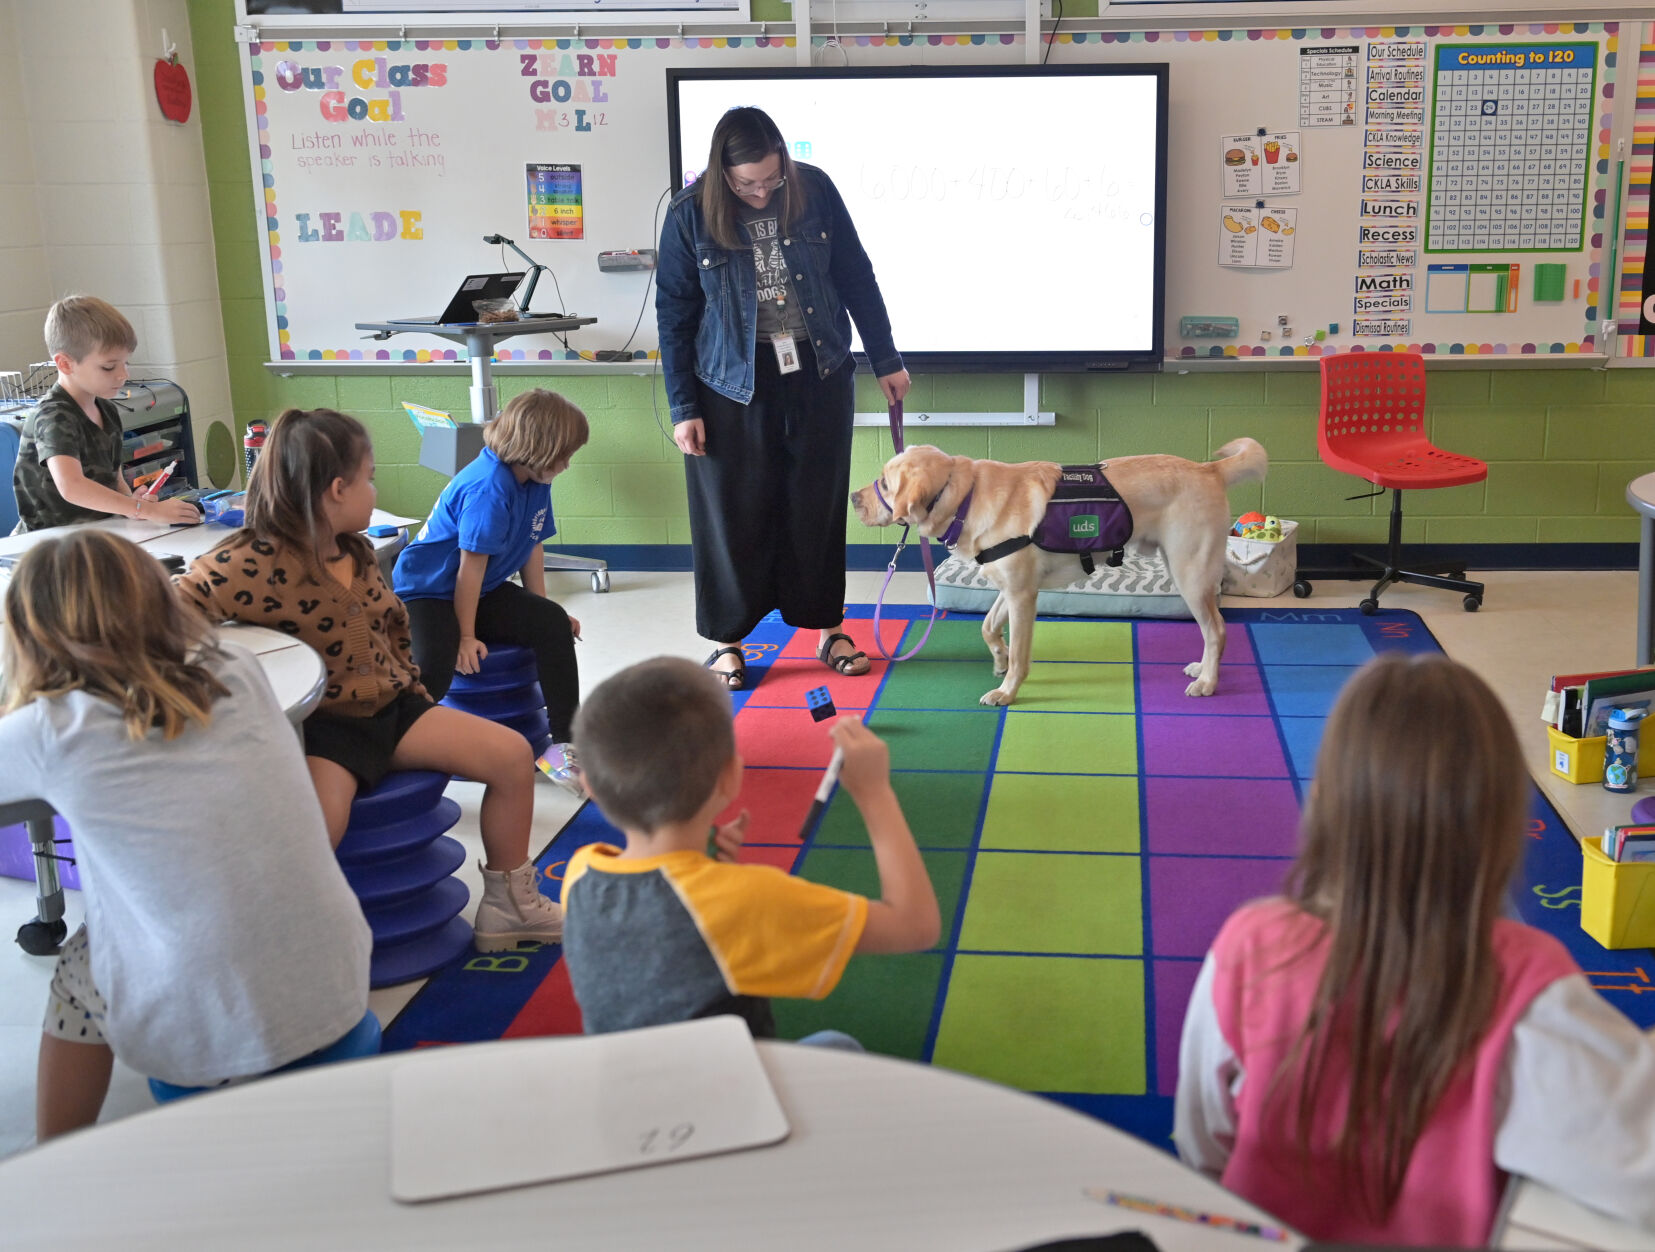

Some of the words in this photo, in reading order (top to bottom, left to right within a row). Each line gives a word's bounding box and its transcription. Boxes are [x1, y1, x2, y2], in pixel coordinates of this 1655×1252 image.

[1370, 46, 1386, 57] Our
[1387, 44, 1423, 57] Schedule
[1458, 51, 1525, 67] Counting
[1529, 51, 1545, 63] to
[1548, 50, 1574, 62] 120
[520, 53, 618, 78] ZEARN
[275, 60, 344, 92] Our
[352, 57, 448, 90] Class
[1370, 70, 1390, 81] Arrival
[1394, 69, 1423, 80] Routines
[530, 79, 608, 103] GOAL
[1369, 89, 1422, 101] Calendar
[320, 90, 405, 122] Goal
[1369, 110, 1394, 121] Morning
[1396, 110, 1422, 121] Meeting
[291, 131, 342, 150] Listen
[351, 128, 396, 147] while
[408, 127, 440, 147] the
[1367, 132, 1383, 143] CKLA
[1385, 131, 1421, 145] Knowledge
[297, 152, 358, 174] speaker
[368, 153, 382, 168] is
[386, 150, 447, 176] talking
[1367, 154, 1419, 168] Science
[538, 173, 544, 182] 5
[538, 184, 545, 193] 4
[1366, 178, 1392, 190] CKLA
[1395, 178, 1418, 189] Skills
[539, 196, 546, 204] 3
[1363, 202, 1416, 216] Lunch
[296, 210, 424, 242] LEADE
[754, 222, 766, 237] IS
[541, 228, 547, 238] 0
[1362, 229, 1415, 241] Recess
[1362, 254, 1394, 265] Scholastic
[1396, 254, 1414, 265] News
[1359, 277, 1410, 290] Math
[757, 285, 786, 302] DOGS
[1357, 298, 1409, 310] Specials
[1356, 322, 1382, 334] Dismissal
[1384, 322, 1408, 333] Routines
[1082, 473, 1094, 482] Dog
[1073, 520, 1095, 532] uds
[1260, 612, 1342, 622] Mm
